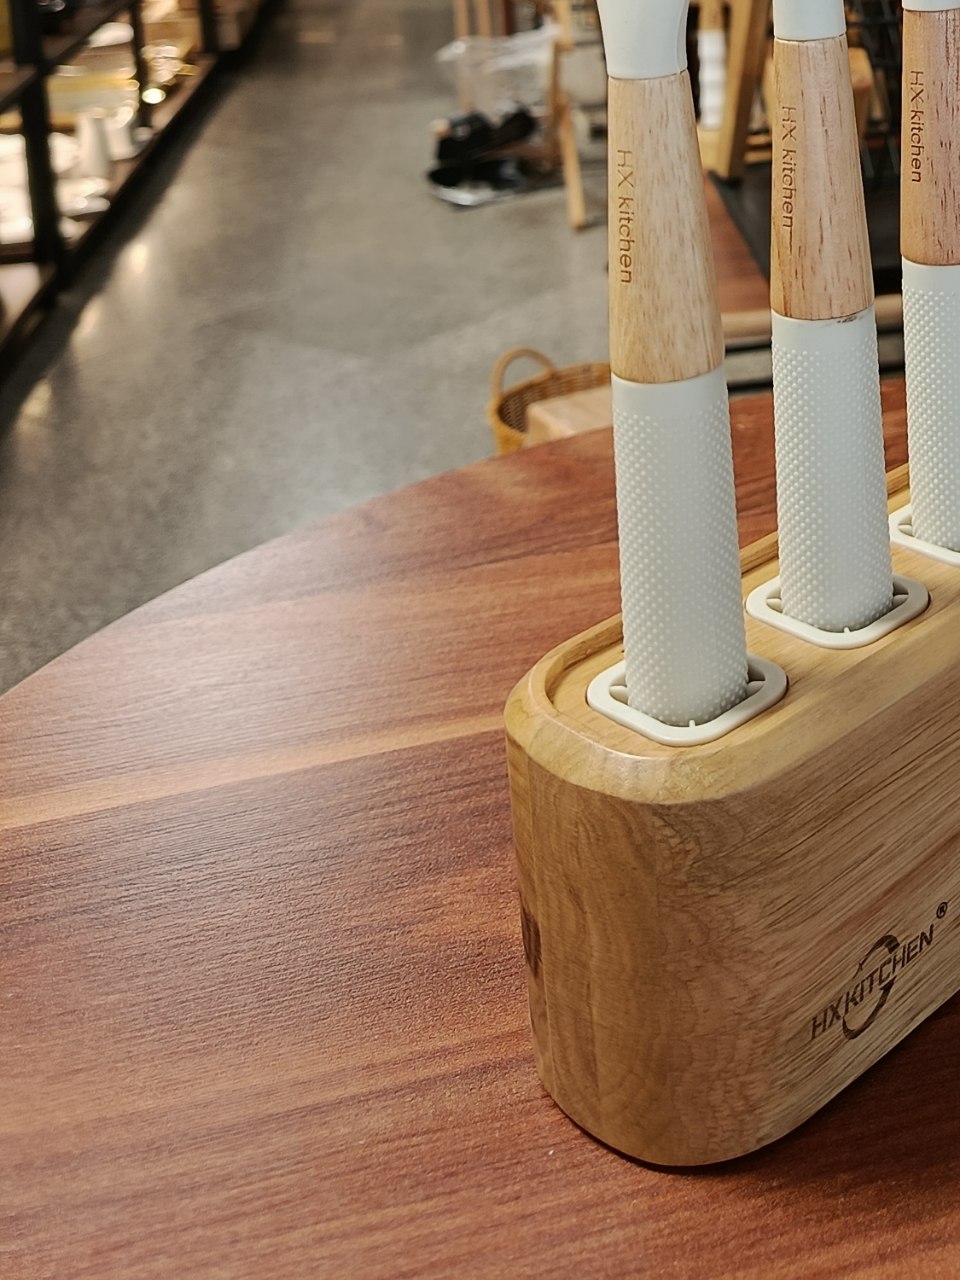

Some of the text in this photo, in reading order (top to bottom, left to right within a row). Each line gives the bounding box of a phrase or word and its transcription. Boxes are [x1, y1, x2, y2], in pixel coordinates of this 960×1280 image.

[617, 149, 635, 284] HX kitchen
[782, 106, 797, 228] HX kitchen
